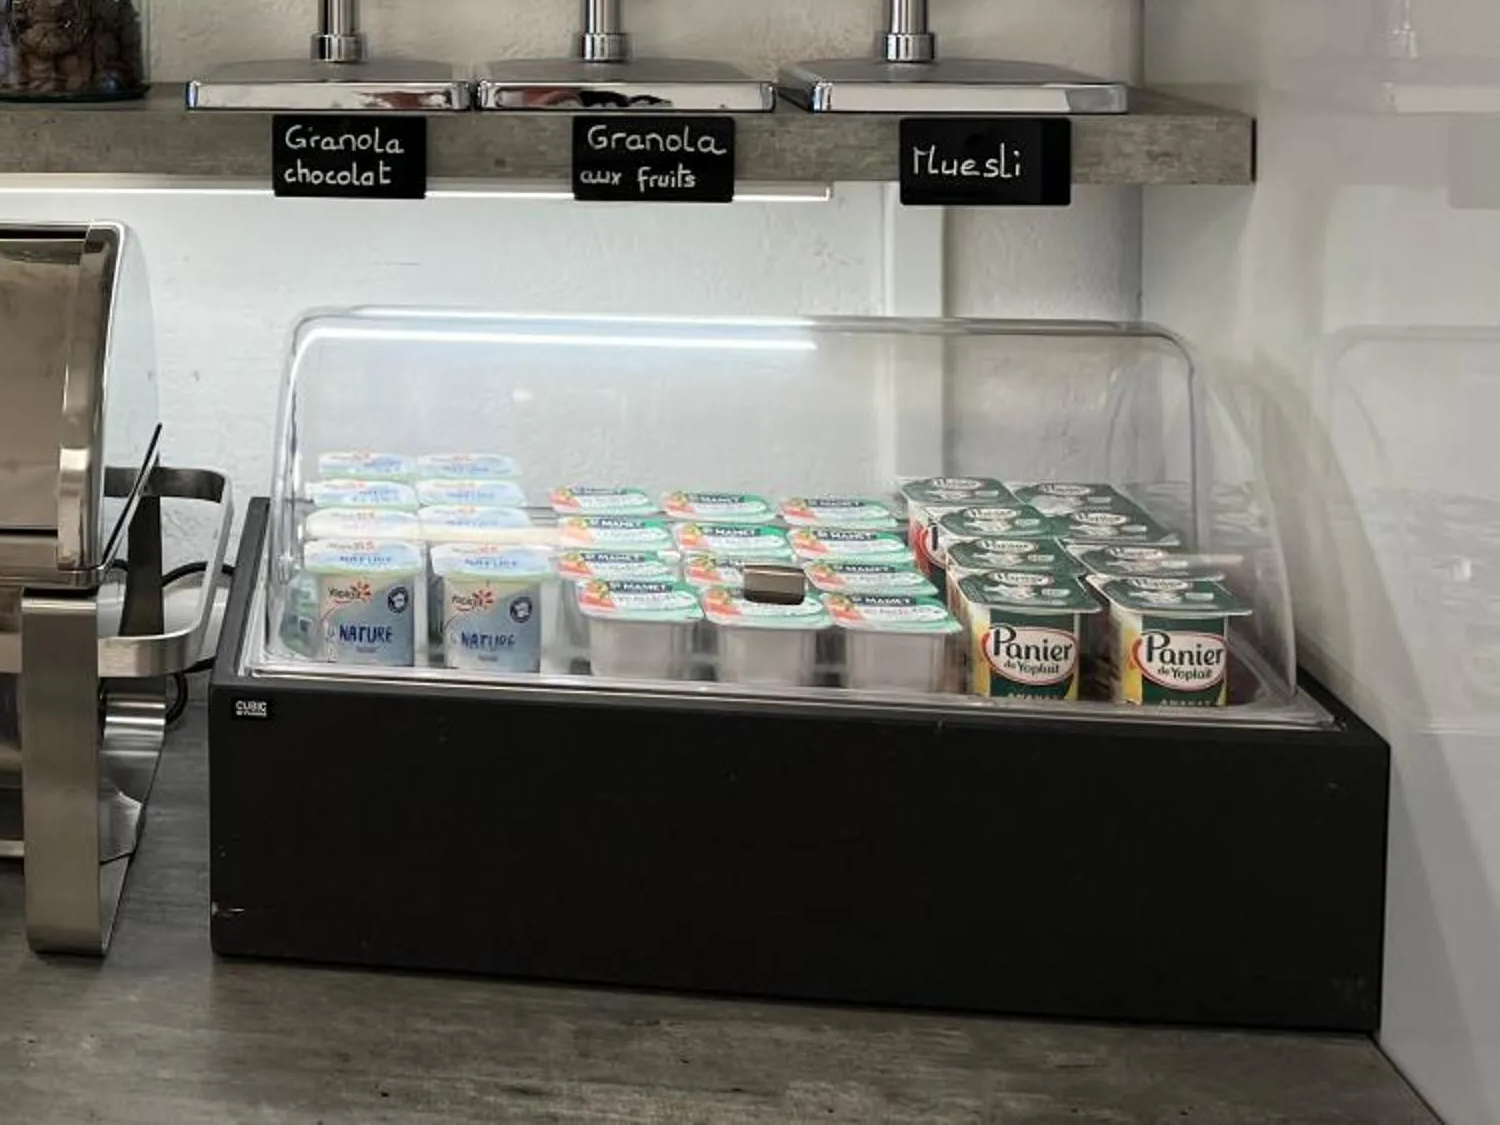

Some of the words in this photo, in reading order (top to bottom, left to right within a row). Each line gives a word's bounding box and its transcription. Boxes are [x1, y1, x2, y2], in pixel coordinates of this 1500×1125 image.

[285, 125, 404, 154] Granola
[587, 125, 727, 155] Granola
[284, 159, 391, 186] chocolat
[580, 170, 622, 185] aux
[637, 163, 696, 193] fruits
[340, 624, 393, 644] NATURE
[989, 626, 1073, 662] Panier
[1141, 630, 1224, 666] Panier
